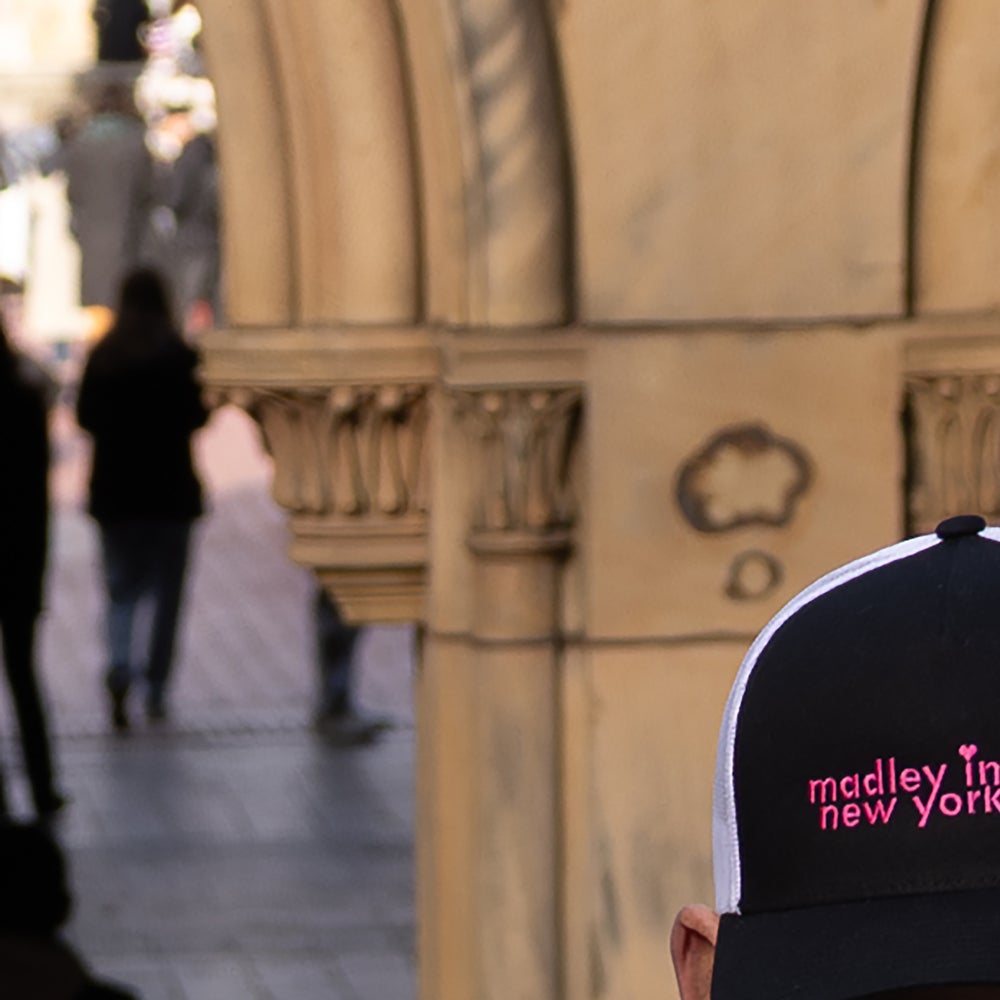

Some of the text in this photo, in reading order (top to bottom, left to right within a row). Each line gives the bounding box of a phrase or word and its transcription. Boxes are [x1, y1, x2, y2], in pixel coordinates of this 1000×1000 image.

[808, 757, 948, 808] madley
[958, 744, 1000, 788] in
[819, 797, 898, 831] new
